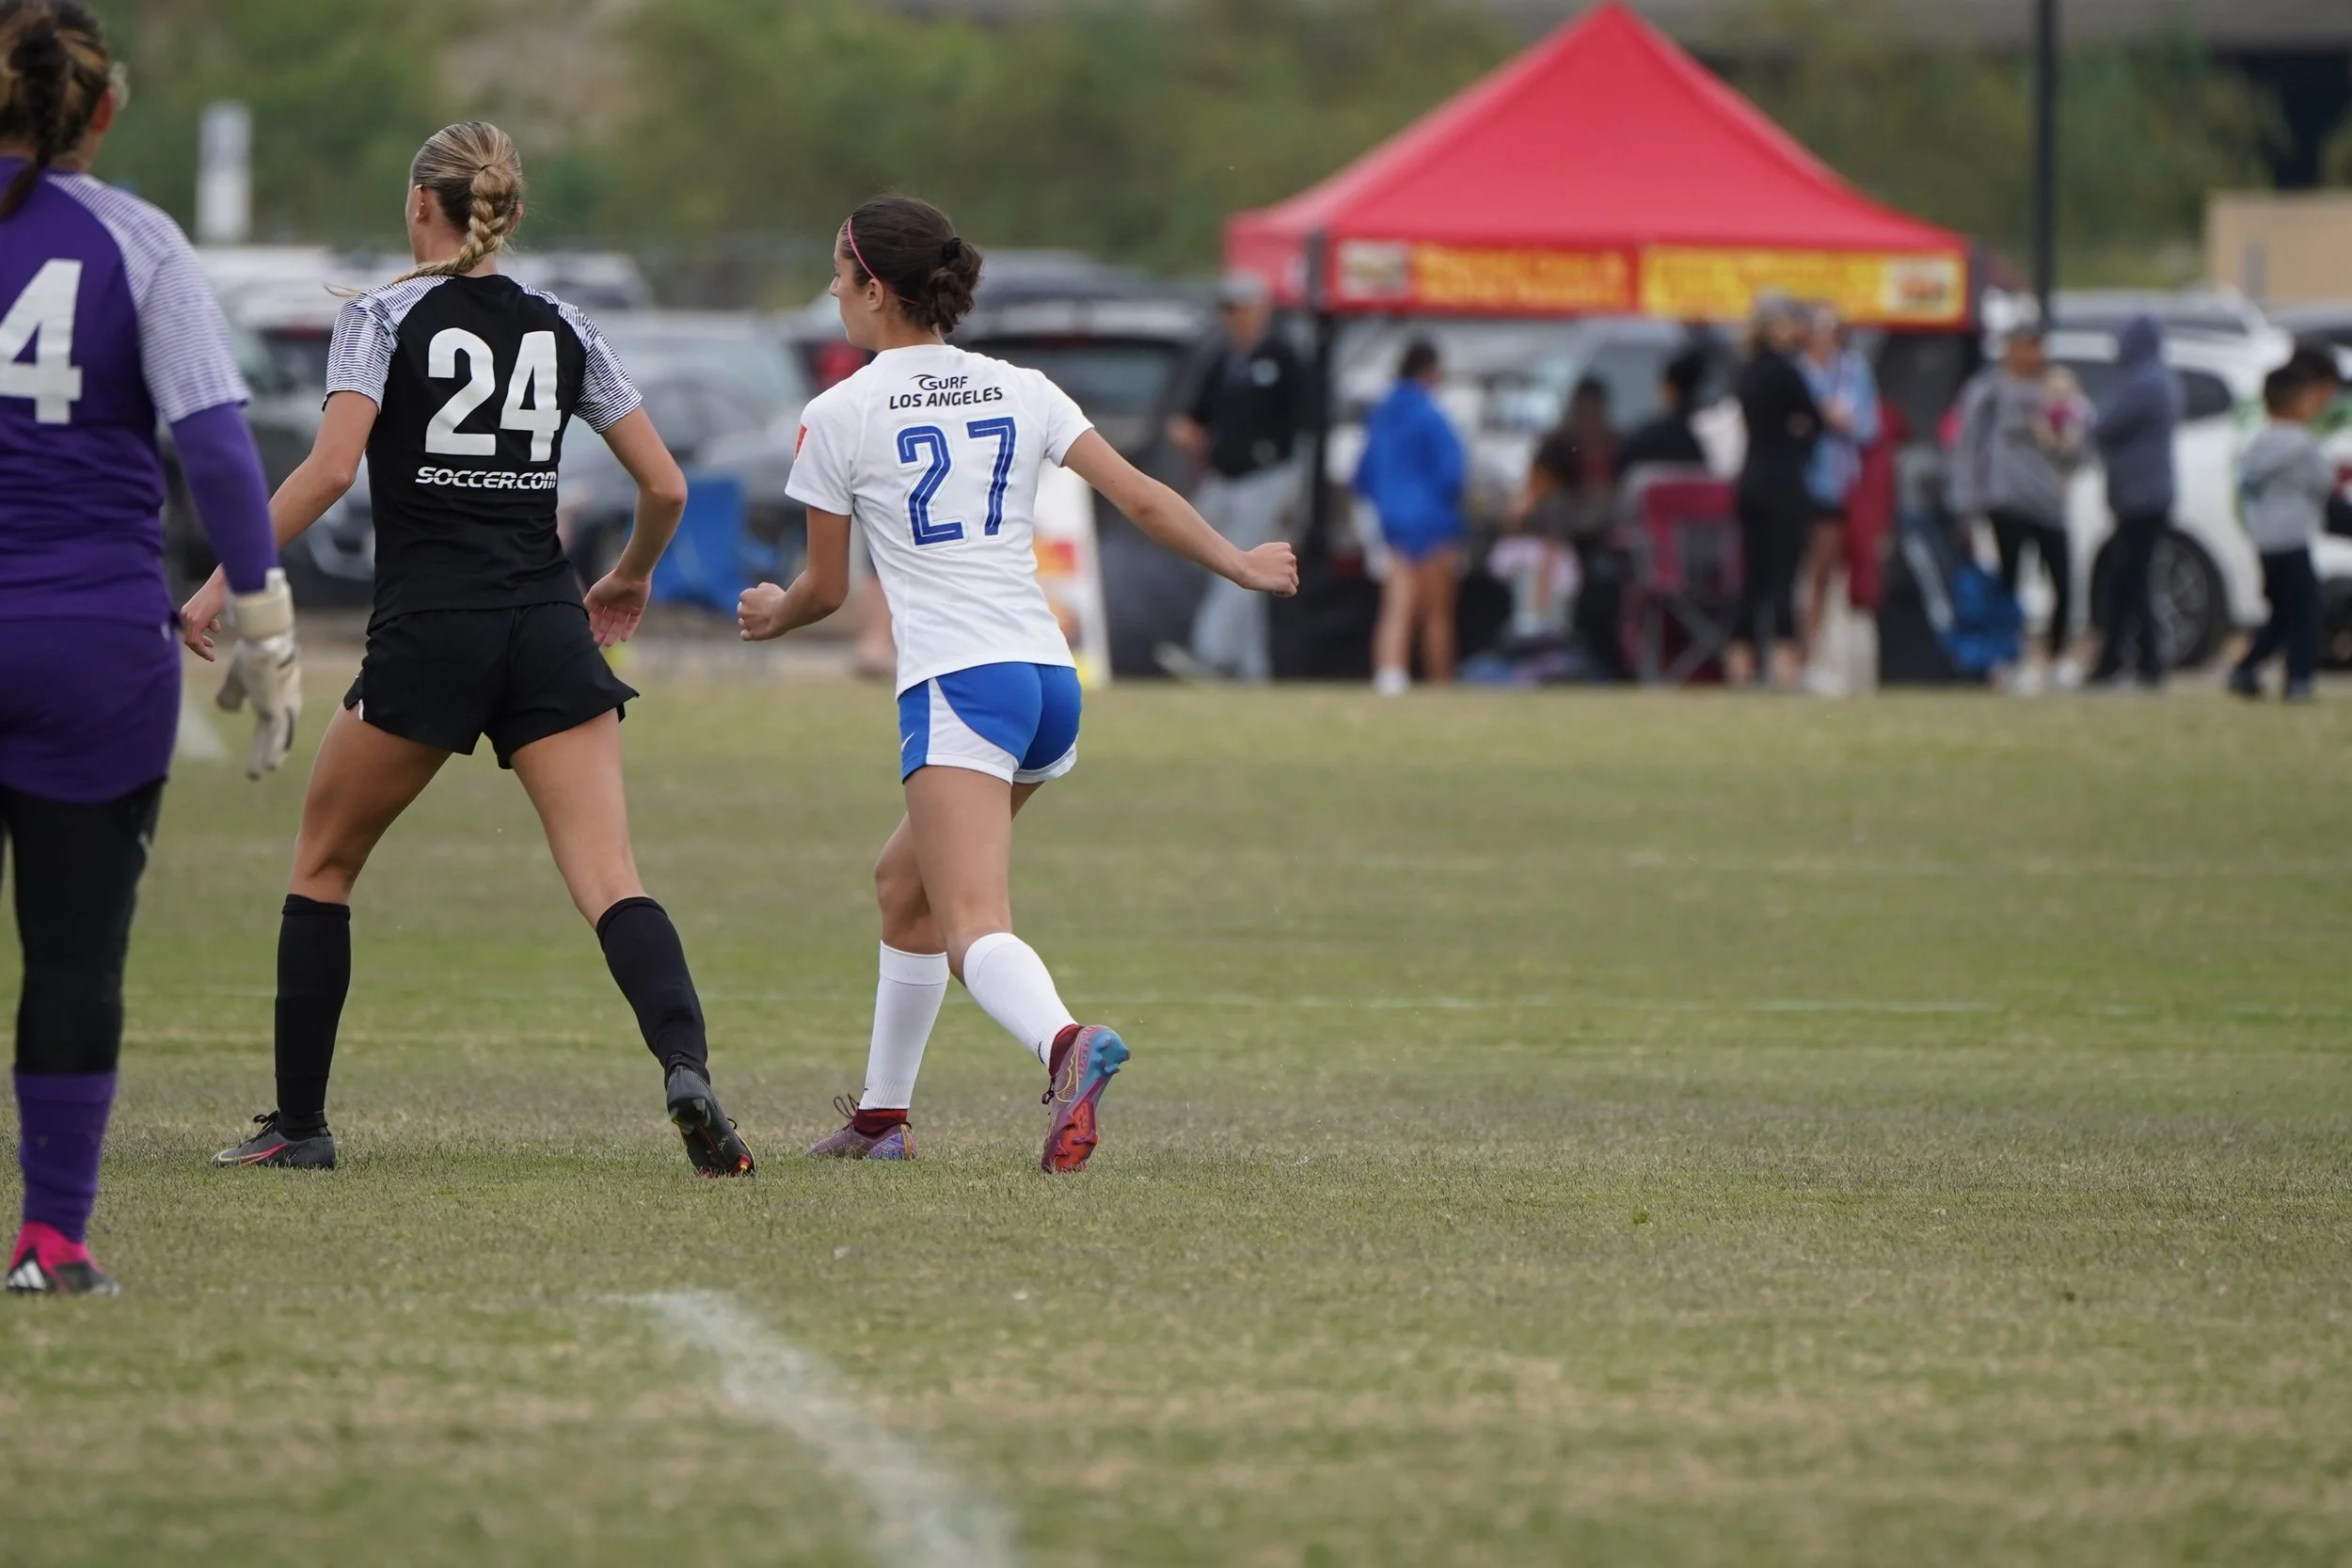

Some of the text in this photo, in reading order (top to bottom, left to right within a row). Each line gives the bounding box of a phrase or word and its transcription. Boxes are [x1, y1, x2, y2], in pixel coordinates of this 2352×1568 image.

[0, 258, 83, 423] 4
[425, 327, 562, 462] 24
[889, 387, 1003, 409] LOS ANGELES
[912, 374, 968, 390] SURF
[415, 467, 557, 489] SOCCER.COM
[896, 417, 1016, 546] 27
